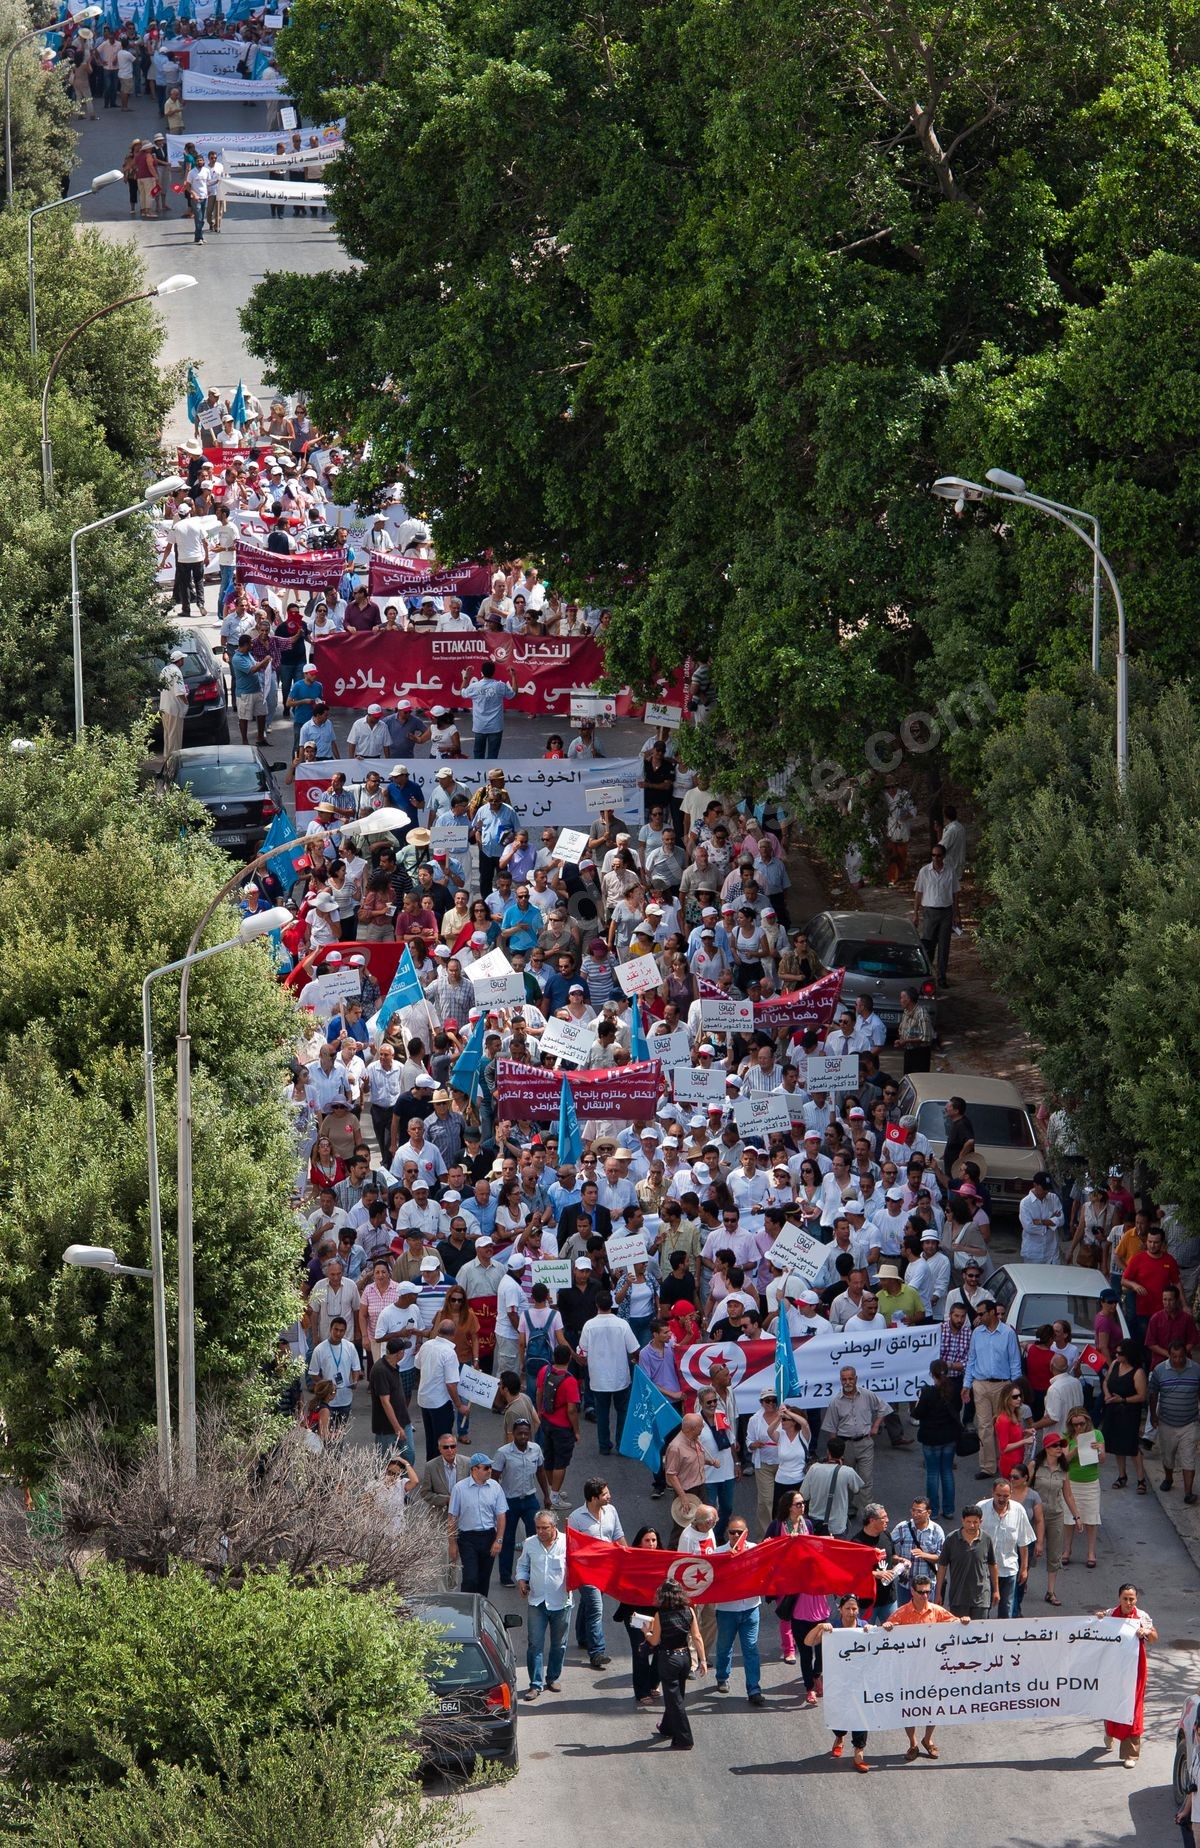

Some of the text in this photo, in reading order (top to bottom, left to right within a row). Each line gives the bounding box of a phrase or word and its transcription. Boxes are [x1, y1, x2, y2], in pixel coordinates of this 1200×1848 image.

[432, 639, 489, 654] ETTAKATOL
[512, 643, 571, 660] التكتل
[334, 667, 444, 697] على بلادو
[527, 769, 581, 787] الخوف
[532, 800, 553, 817] لن
[523, 1091, 534, 1099] 23
[601, 1090, 627, 1099] ملتزم
[829, 1332, 938, 1365] التوافق الوطني
[812, 1382, 833, 1397] 23
[838, 1627, 1122, 1661] مستقلو القطب الحداثي الديمقراطي
[939, 1653, 1021, 1675] لا للرجعية
[863, 1677, 1099, 1704] Les du PDM
[900, 1680, 1021, 1702] indépendants
[902, 1697, 1060, 1718] NON A LA REGRESSION
